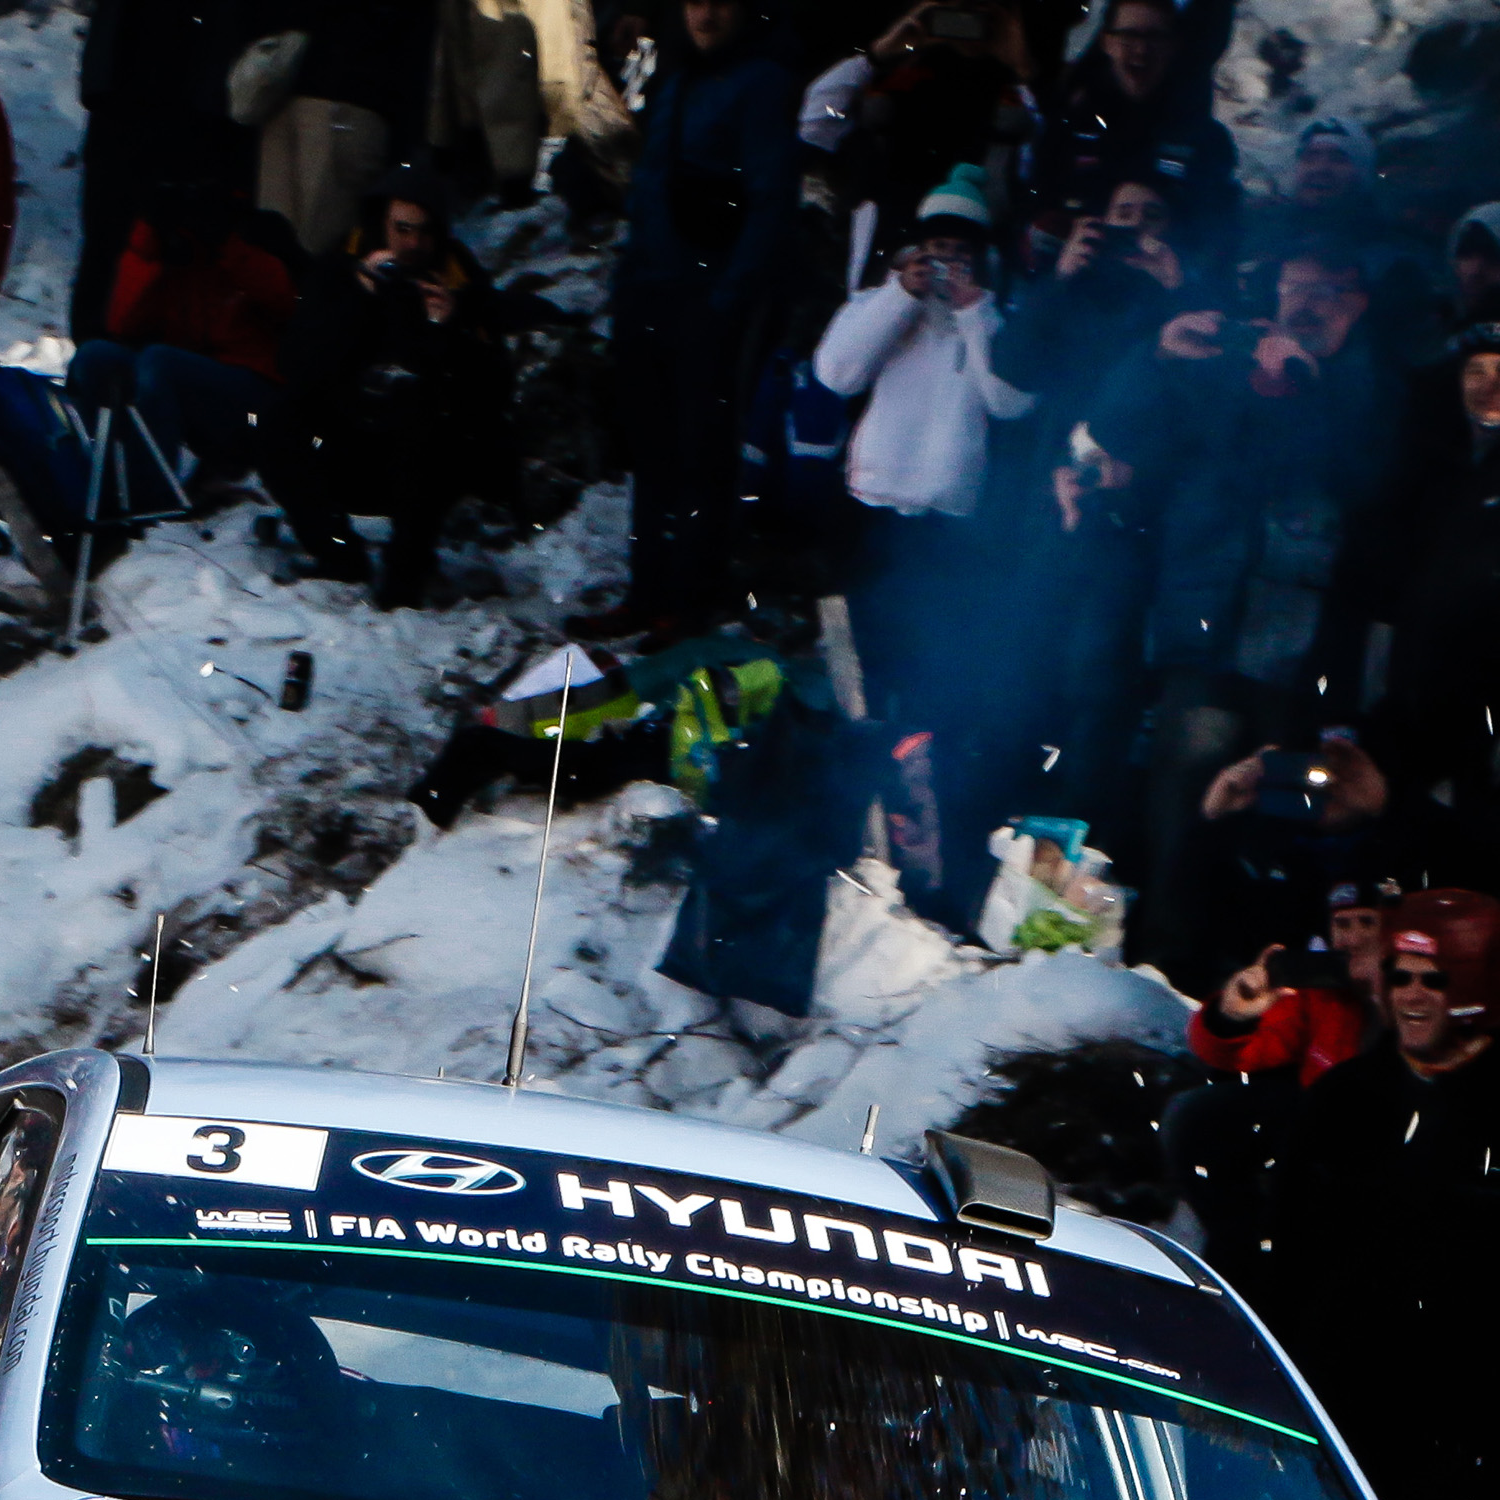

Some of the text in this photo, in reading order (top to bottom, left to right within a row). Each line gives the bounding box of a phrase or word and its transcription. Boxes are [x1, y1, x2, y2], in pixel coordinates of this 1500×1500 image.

[186, 1125, 246, 1173] 3
[331, 1215, 405, 1241] FIA
[416, 1222, 547, 1255] World
[562, 1235, 672, 1275] Rally
[684, 1253, 987, 1333] Championship
[558, 1172, 1051, 1297] HYUNDAI
